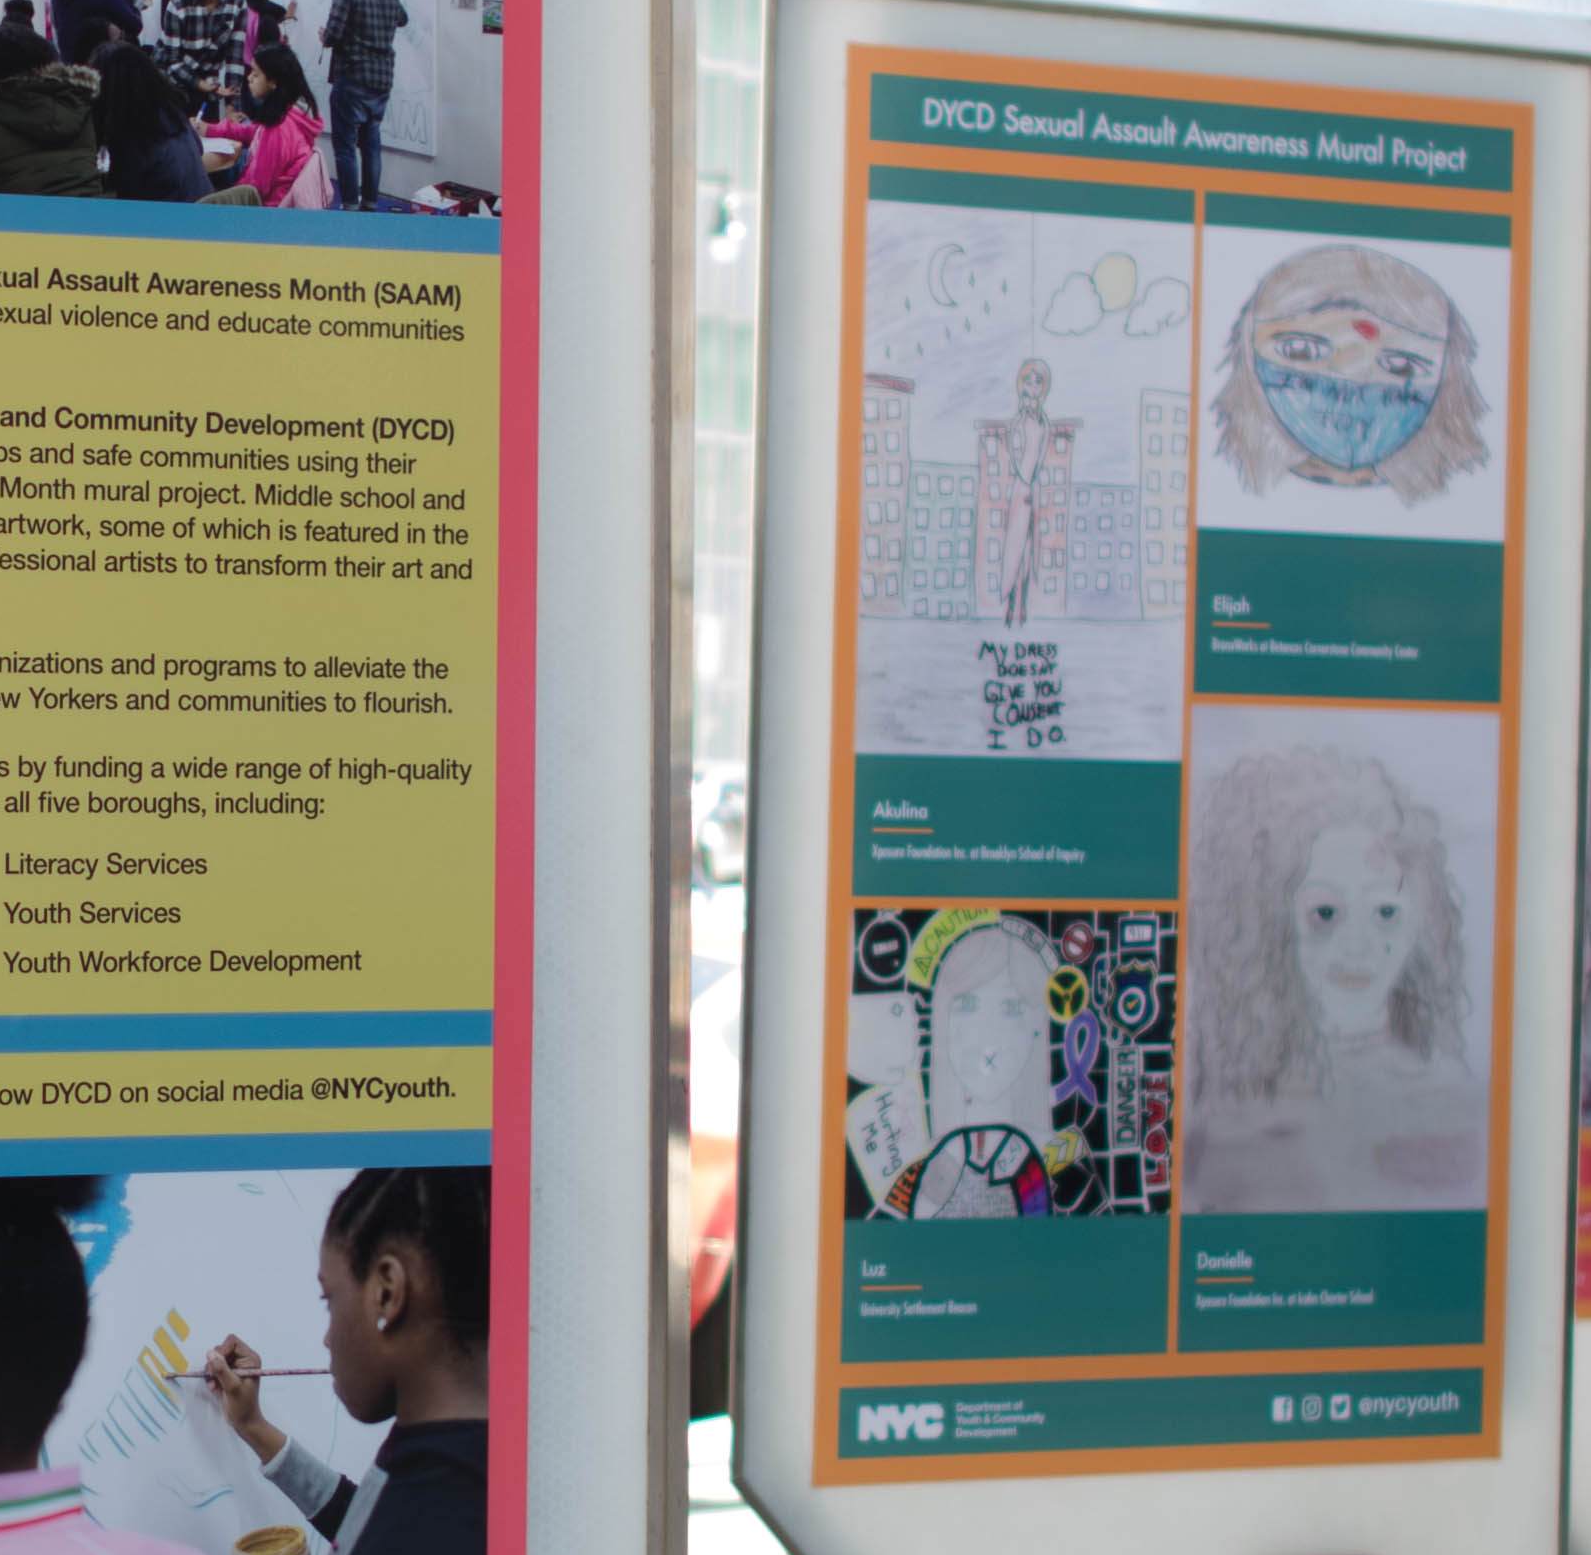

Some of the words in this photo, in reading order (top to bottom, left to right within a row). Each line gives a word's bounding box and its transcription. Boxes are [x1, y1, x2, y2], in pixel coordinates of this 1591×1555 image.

[922, 96, 996, 132] DYCD
[1003, 103, 1085, 138] Sexual
[1089, 111, 1177, 146] Assault
[1181, 119, 1309, 158] Awareness
[1316, 131, 1384, 164] Mural
[1391, 137, 1467, 177] Project
[45, 267, 141, 294] Assault
[145, 271, 282, 300] Awareness
[289, 277, 367, 303] Month
[373, 280, 462, 312] (SAAM)
[59, 303, 159, 330] violence
[164, 308, 210, 332] and
[216, 310, 312, 336] educate
[317, 317, 465, 342] communities
[0, 405, 47, 429] and
[53, 405, 199, 439] Community
[205, 410, 366, 442] Development
[371, 415, 455, 447] (DYCD)
[1213, 594, 1251, 617] Elijah
[984, 679, 1026, 704] GIVE
[1033, 678, 1062, 698] YOU
[873, 801, 929, 820] Akulina
[4, 851, 99, 881] Literacy
[105, 851, 208, 875] Services
[2, 900, 72, 925] Youth
[78, 900, 181, 925] Services
[2, 949, 71, 974] Youth
[77, 949, 202, 973] Workforce
[209, 948, 363, 977] Development
[41, 1080, 112, 1105] DYCD
[118, 1085, 149, 1104] on
[156, 1078, 225, 1103] social
[231, 1077, 305, 1102] media
[309, 1075, 456, 1104] @NYCyouth.
[1116, 1050, 1137, 1144] DANGER
[861, 1259, 887, 1278] Luz
[1197, 1250, 1253, 1270] Danielle
[1358, 1391, 1460, 1418] @nycyouth
[857, 1402, 945, 1442] NYC
